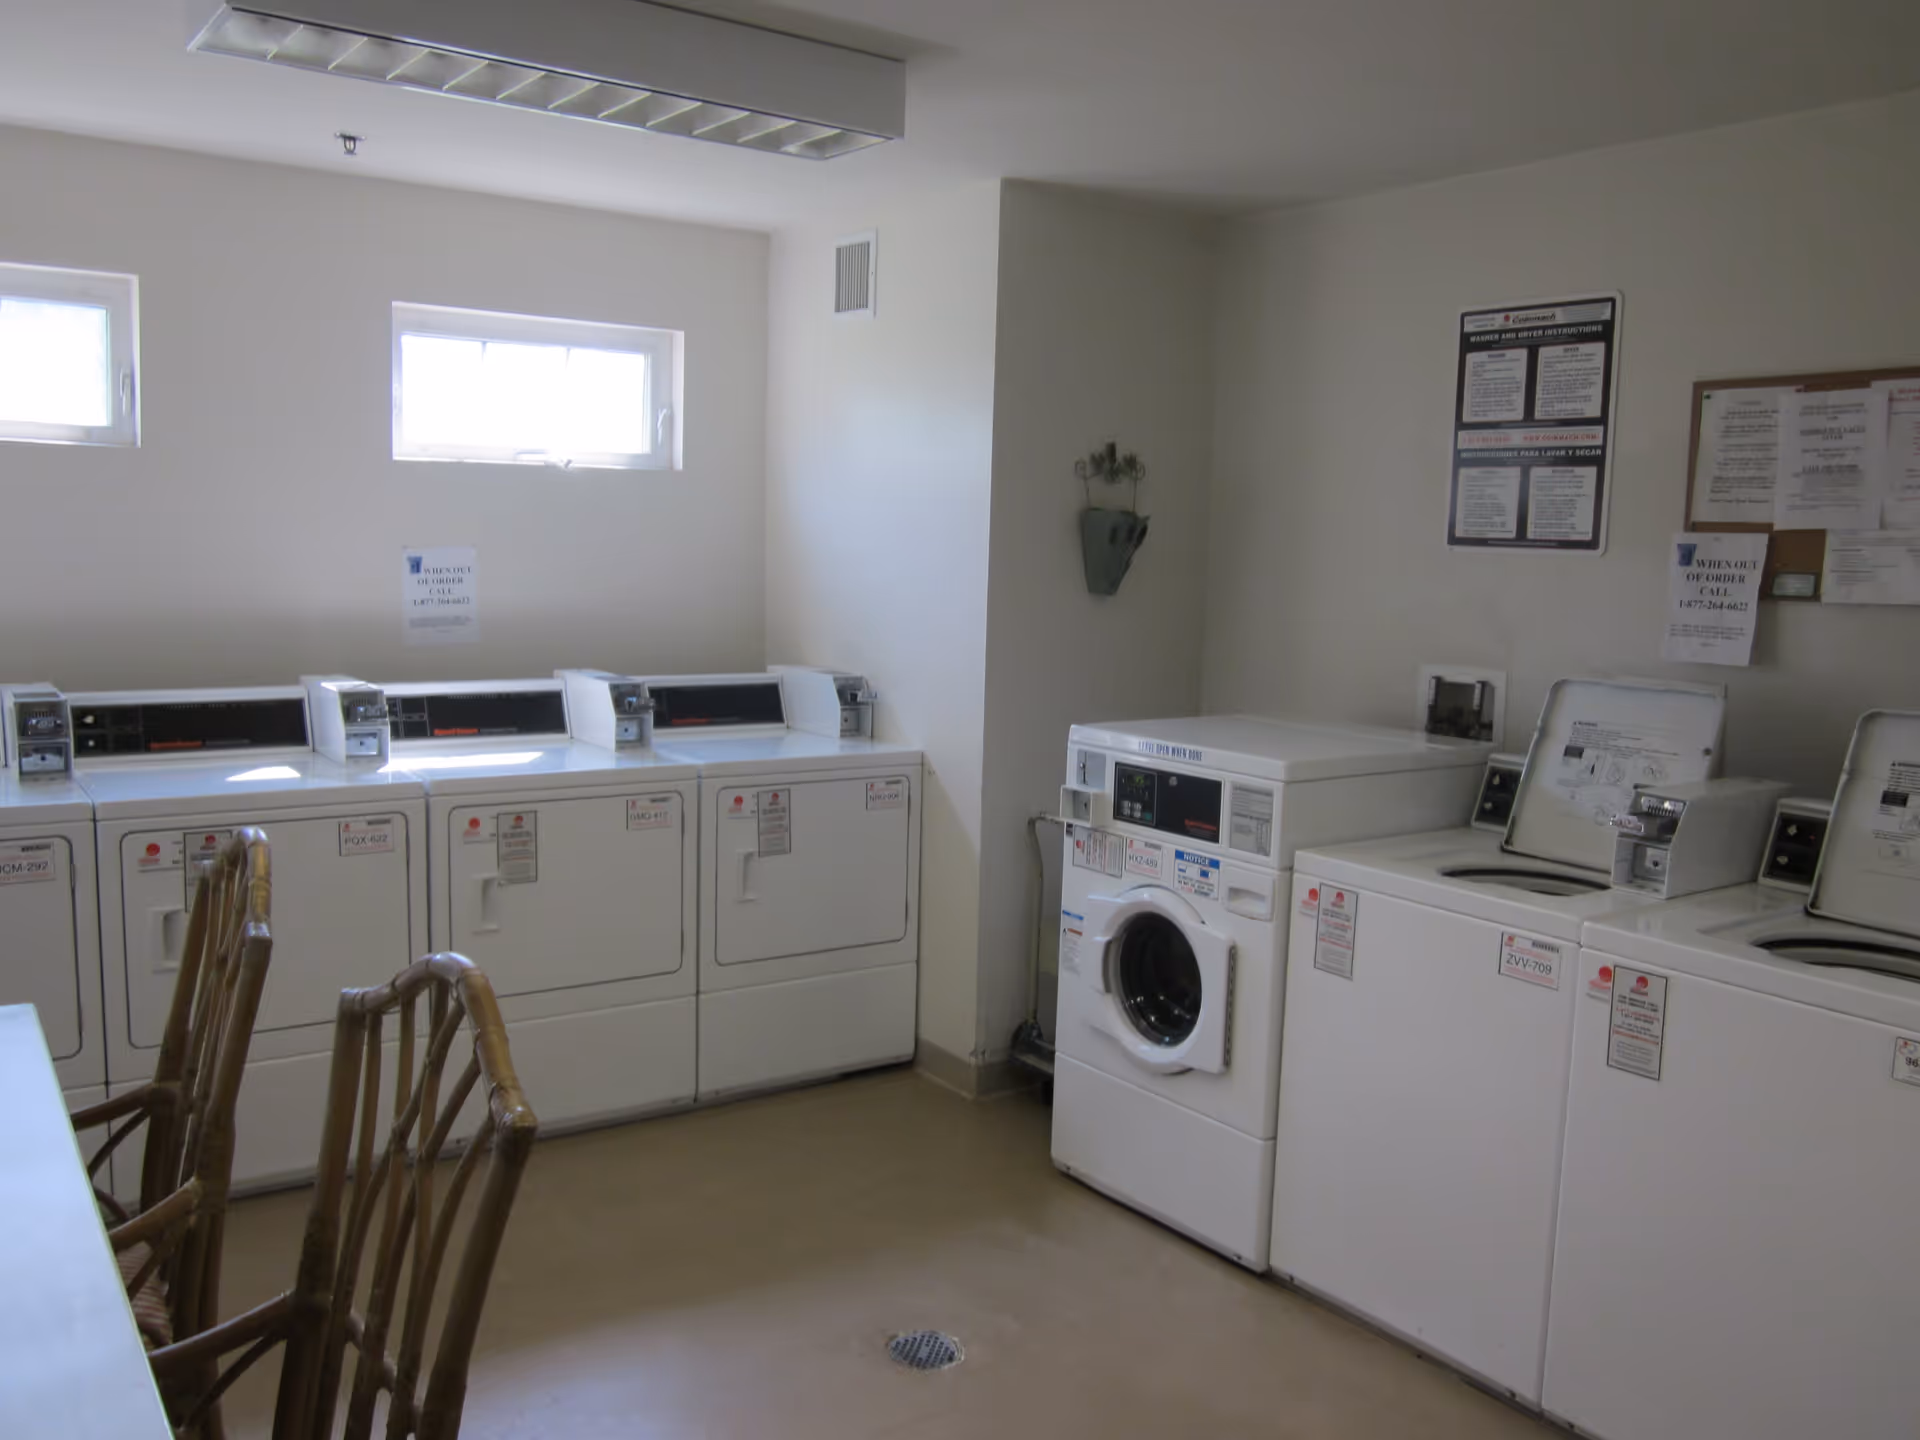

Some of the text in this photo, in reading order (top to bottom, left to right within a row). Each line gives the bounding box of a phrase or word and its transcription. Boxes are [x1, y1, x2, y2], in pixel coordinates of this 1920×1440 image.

[1469, 334, 1499, 343] WASHER
[1518, 330, 1544, 338] DRYER
[1544, 325, 1603, 336] INSTRUCTIONS
[1541, 449, 1566, 457] LAVAR
[1696, 559, 1759, 570] WHEN OUT
[423, 567, 451, 575] WHEN
[432, 576, 463, 585] ORDER
[1686, 572, 1746, 584] OF ORDER
[429, 587, 453, 595] CALL
[1699, 586, 1733, 597] CALL
[1679, 599, 1749, 612] 1-877-264-6622
[1156, 743, 1170, 755] OPEN
[1171, 745, 1187, 758] WHEN
[1188, 749, 1203, 761] DONE
[1183, 853, 1209, 865] NOTICE
[1506, 952, 1552, 976] ZVV-709
